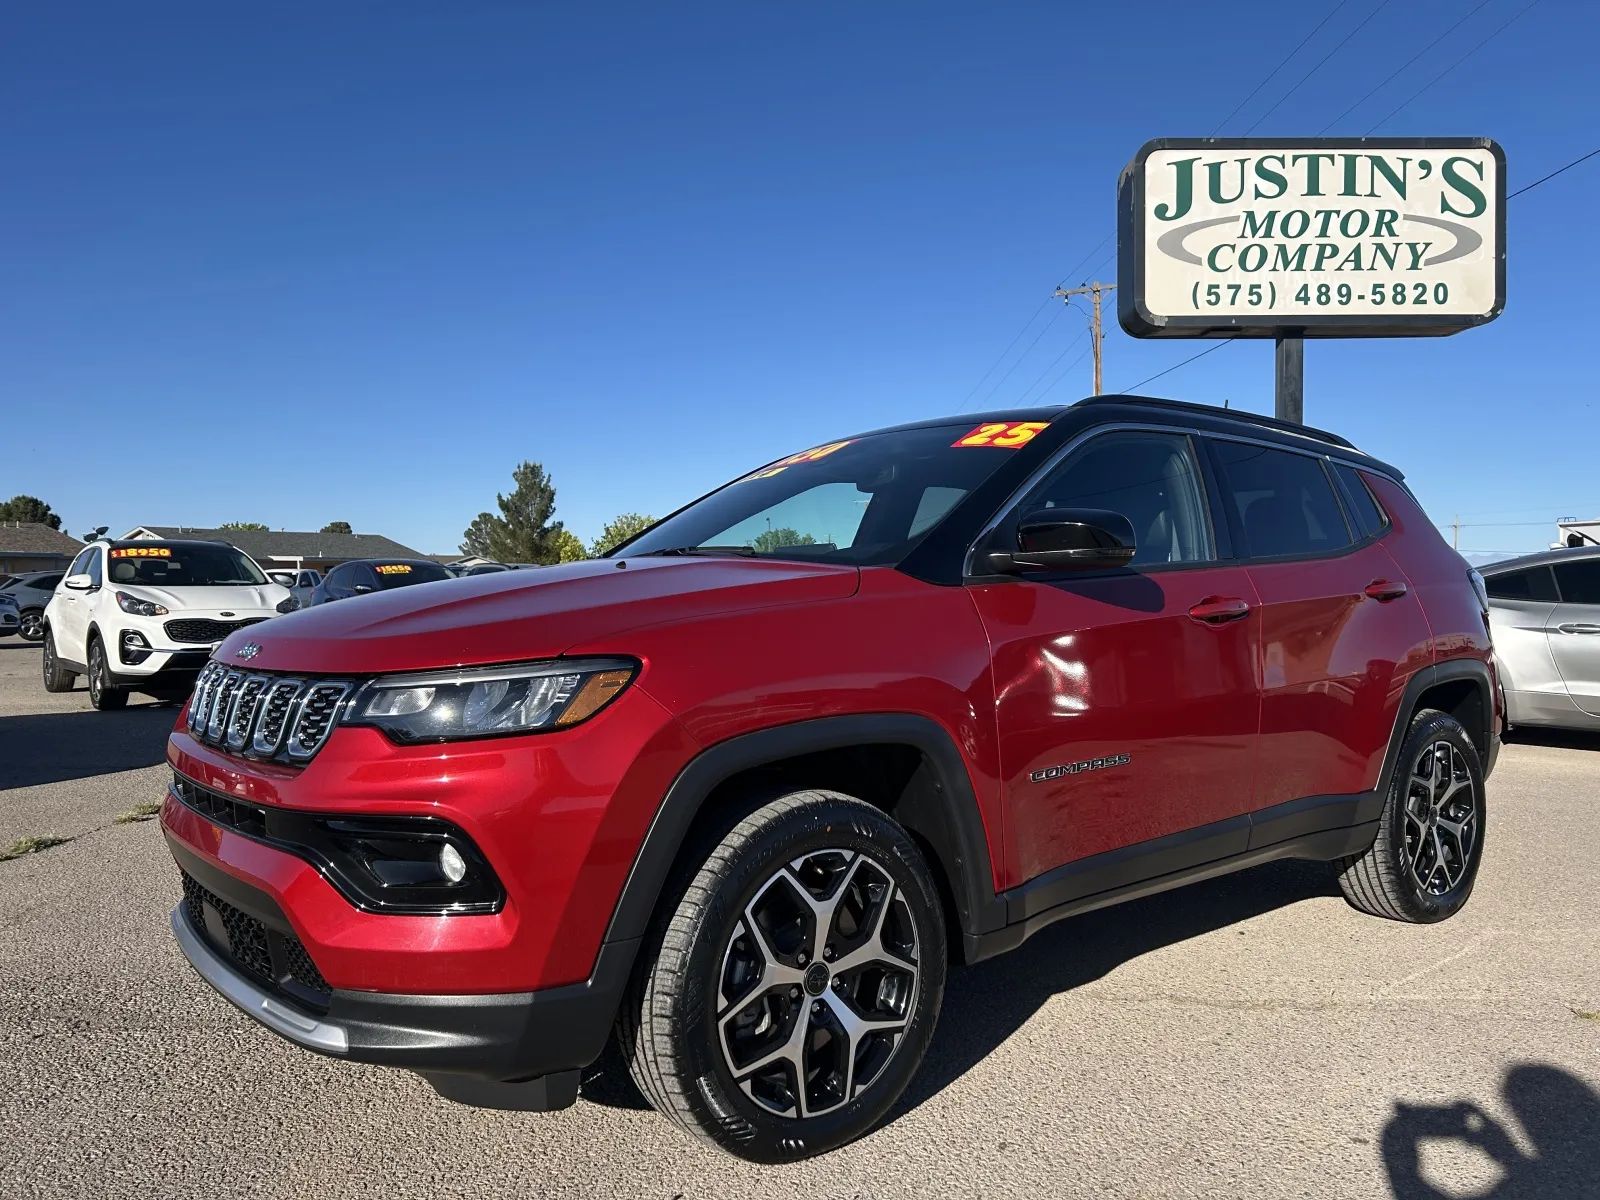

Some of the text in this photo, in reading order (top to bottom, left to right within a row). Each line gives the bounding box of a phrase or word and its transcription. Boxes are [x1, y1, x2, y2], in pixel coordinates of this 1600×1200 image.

[1237, 209, 1402, 240] MOTOR
[1206, 242, 1433, 273] COMPANY
[1192, 281, 1450, 310] (575) 489-5820
[961, 422, 1051, 446] 25
[1029, 753, 1131, 783] COMPASS
